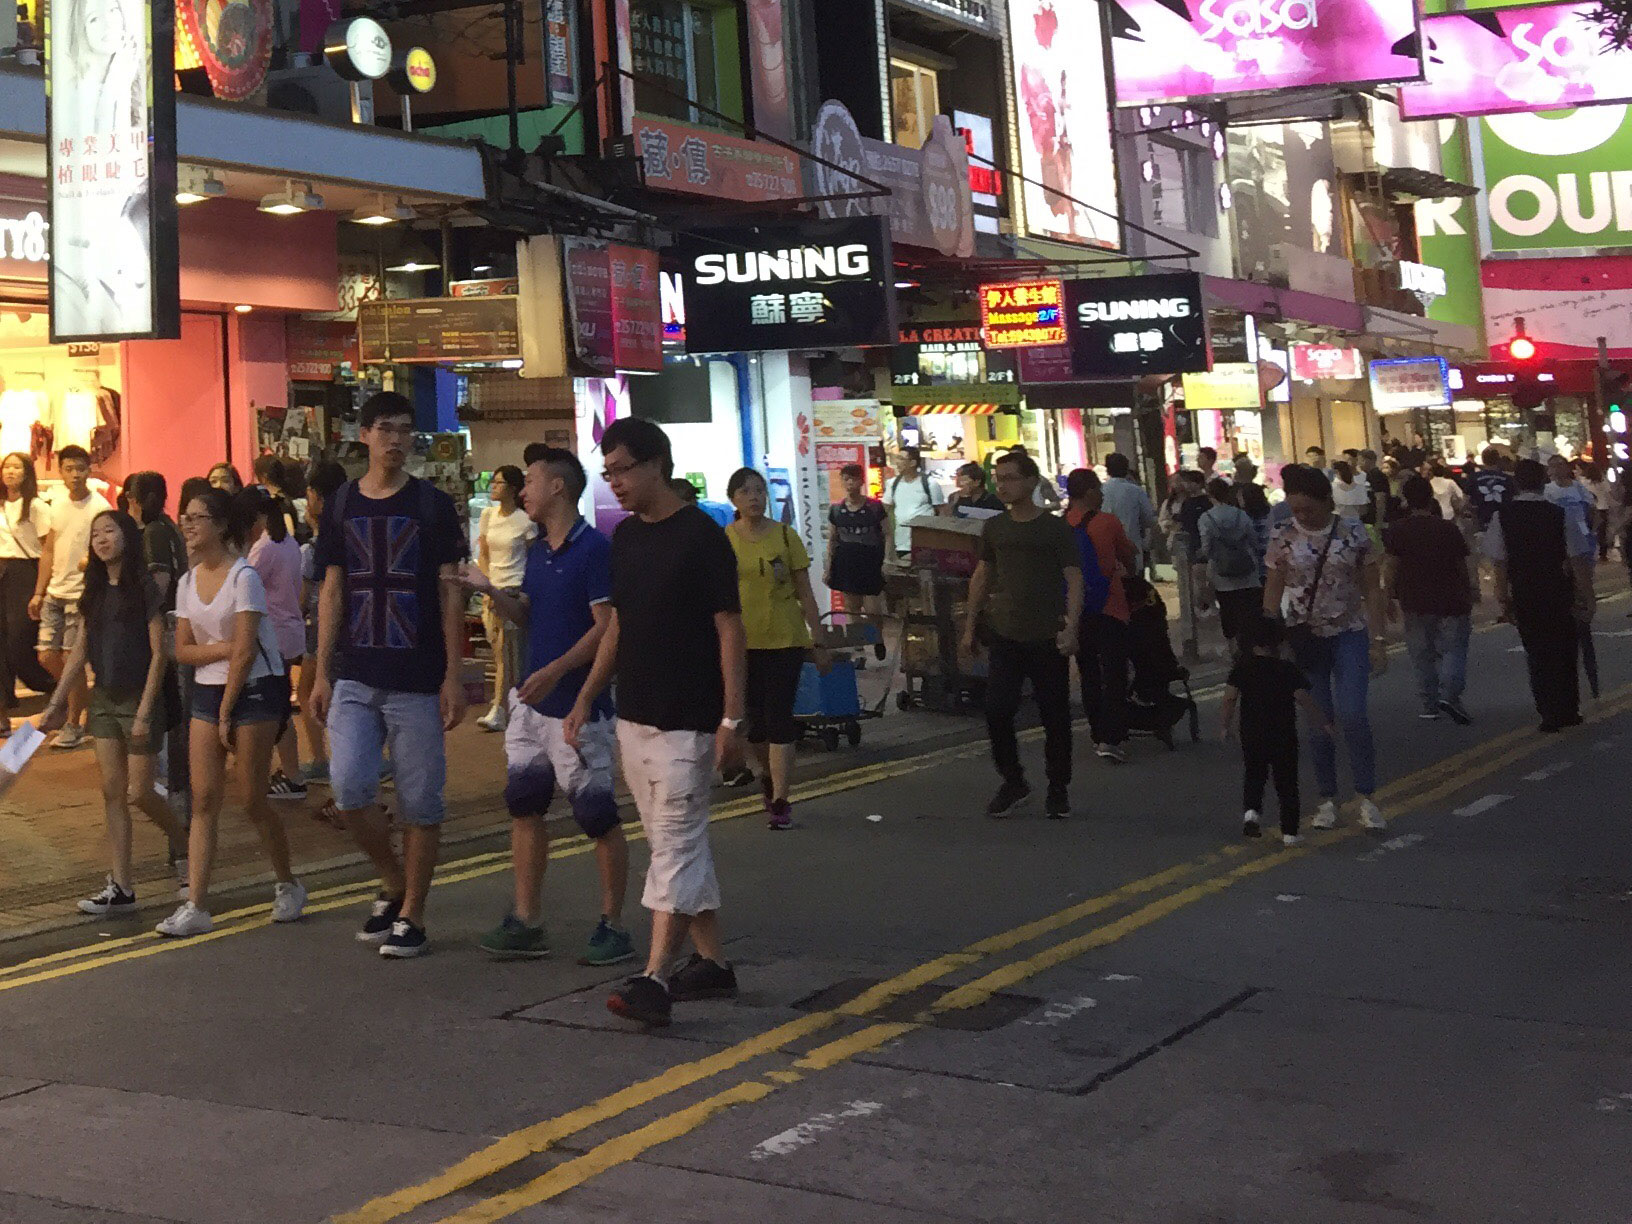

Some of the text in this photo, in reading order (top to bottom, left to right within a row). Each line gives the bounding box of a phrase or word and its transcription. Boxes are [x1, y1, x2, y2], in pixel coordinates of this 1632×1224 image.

[695, 243, 870, 285] SUNING
[749, 291, 826, 326] 蘇寧
[1077, 297, 1190, 322] SUNING
